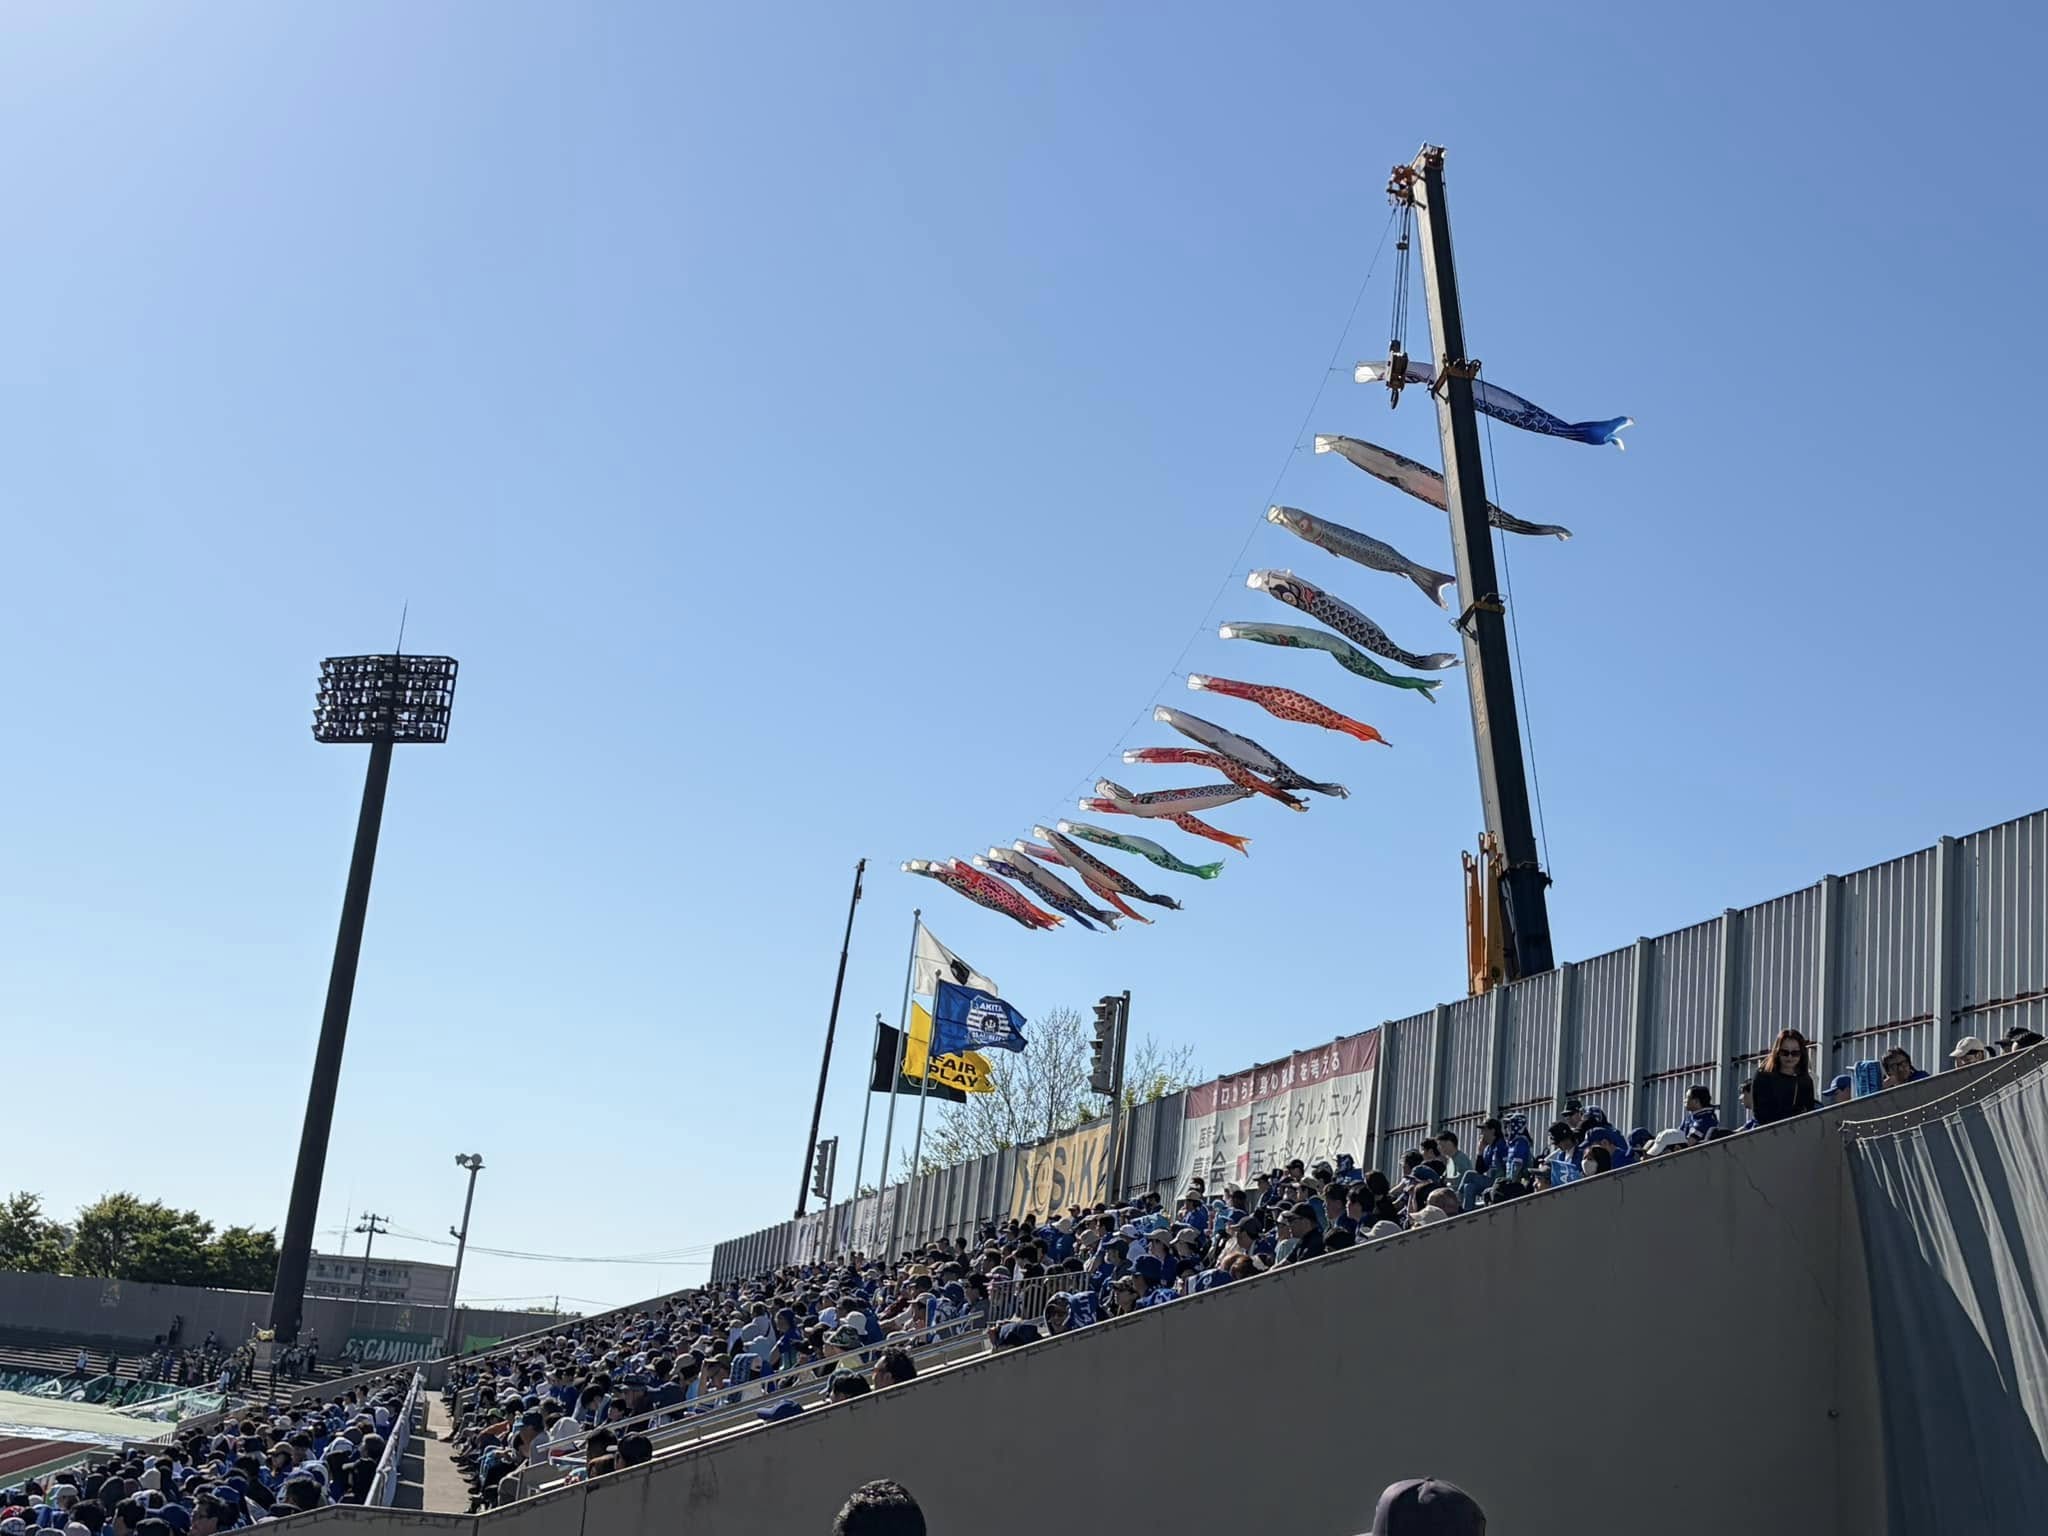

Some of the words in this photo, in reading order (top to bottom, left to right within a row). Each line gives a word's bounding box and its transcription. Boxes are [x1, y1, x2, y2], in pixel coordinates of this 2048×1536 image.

[979, 1001, 1003, 1013] AKITA
[929, 1065, 978, 1087] PLAY
[932, 1056, 976, 1076] FAIR
